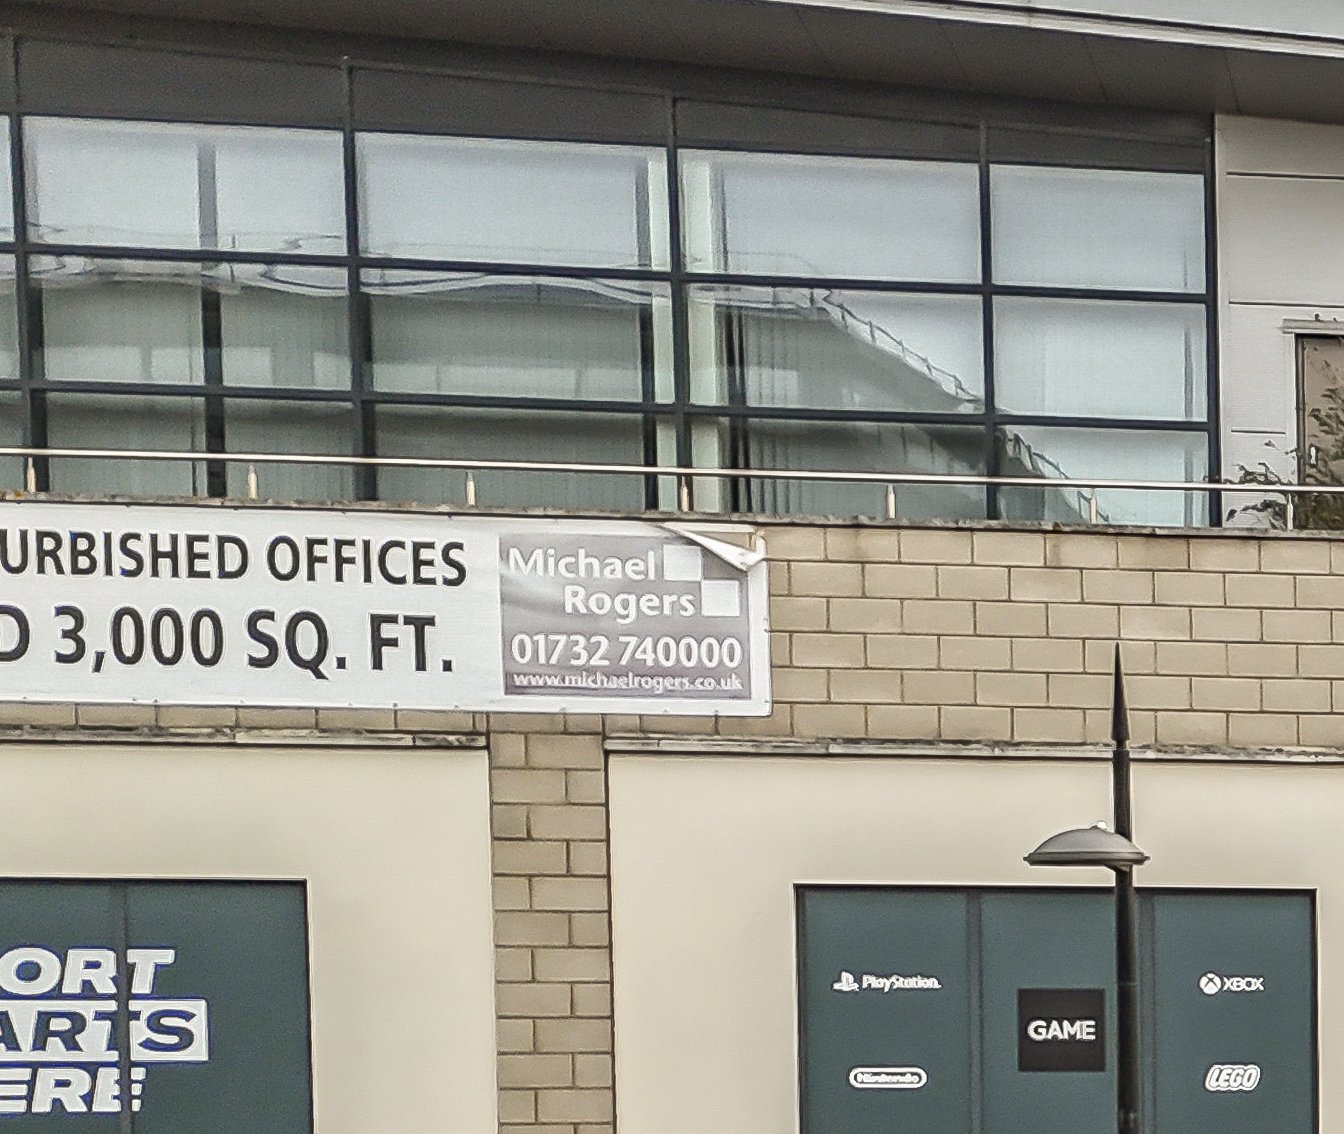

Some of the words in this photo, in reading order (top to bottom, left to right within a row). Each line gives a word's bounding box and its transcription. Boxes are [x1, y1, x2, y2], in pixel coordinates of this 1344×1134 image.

[267, 535, 467, 587] OFFICES
[508, 545, 656, 580] Michael
[563, 585, 696, 625] Rogers
[54, 605, 224, 673] 3,000
[247, 609, 347, 679] SQ.
[370, 613, 453, 671] FT.
[511, 634, 611, 666] 01732
[618, 635, 743, 668] 740000
[513, 671, 743, 694] www.michaelrogers.co.uk
[1223, 977, 1264, 991] XBOX
[1027, 1019, 1096, 1041] GAME
[1209, 1067, 1257, 1089] LEGO
